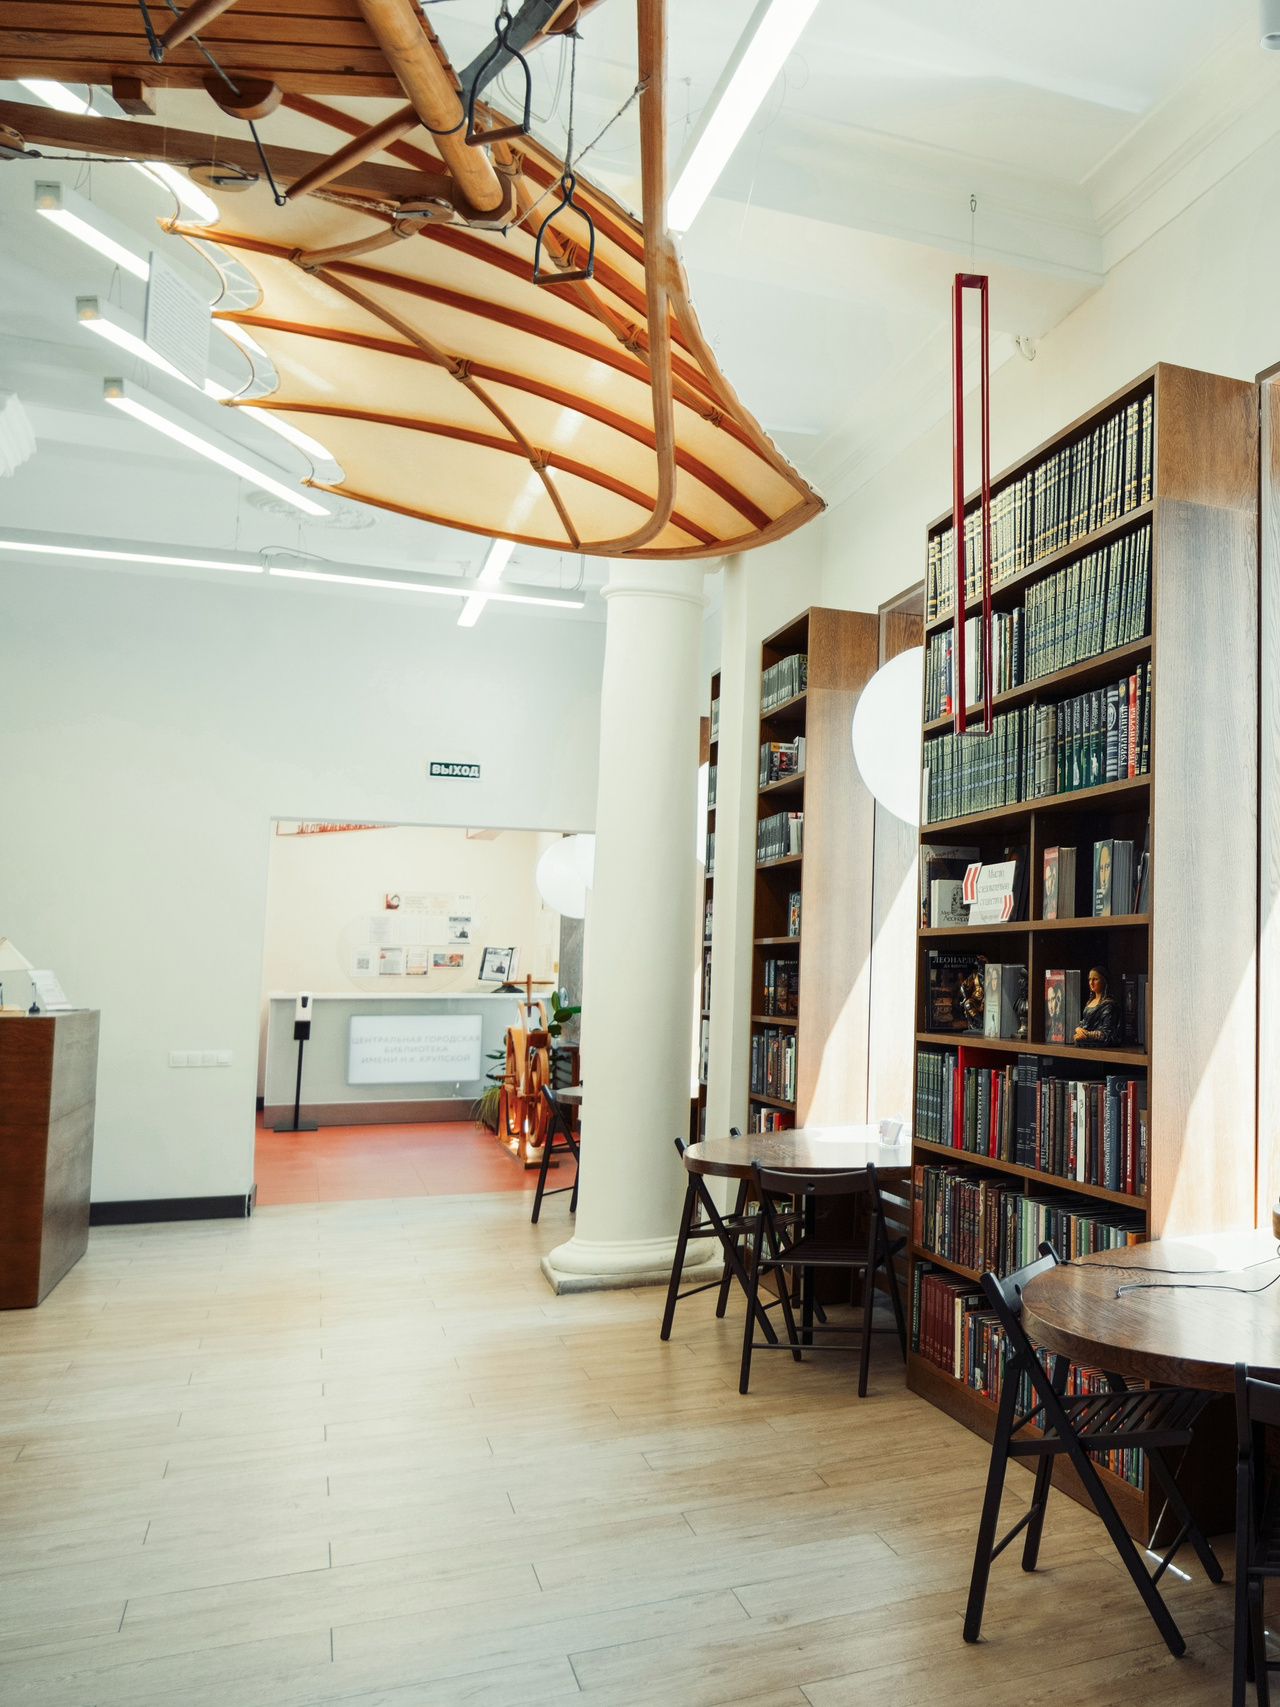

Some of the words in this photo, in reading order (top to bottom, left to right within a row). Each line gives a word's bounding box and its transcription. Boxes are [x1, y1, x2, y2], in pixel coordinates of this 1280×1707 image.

[431, 763, 480, 778] ВЫХОД
[943, 915, 969, 923] Леонард
[933, 955, 979, 964] ЛЕОНАРДО
[351, 1036, 422, 1044] ЦЕНТРАЛЬНАЯ
[425, 1035, 480, 1043] ГОРОДСКАЯ
[419, 1054, 471, 1062] КРУПСКОЙ
